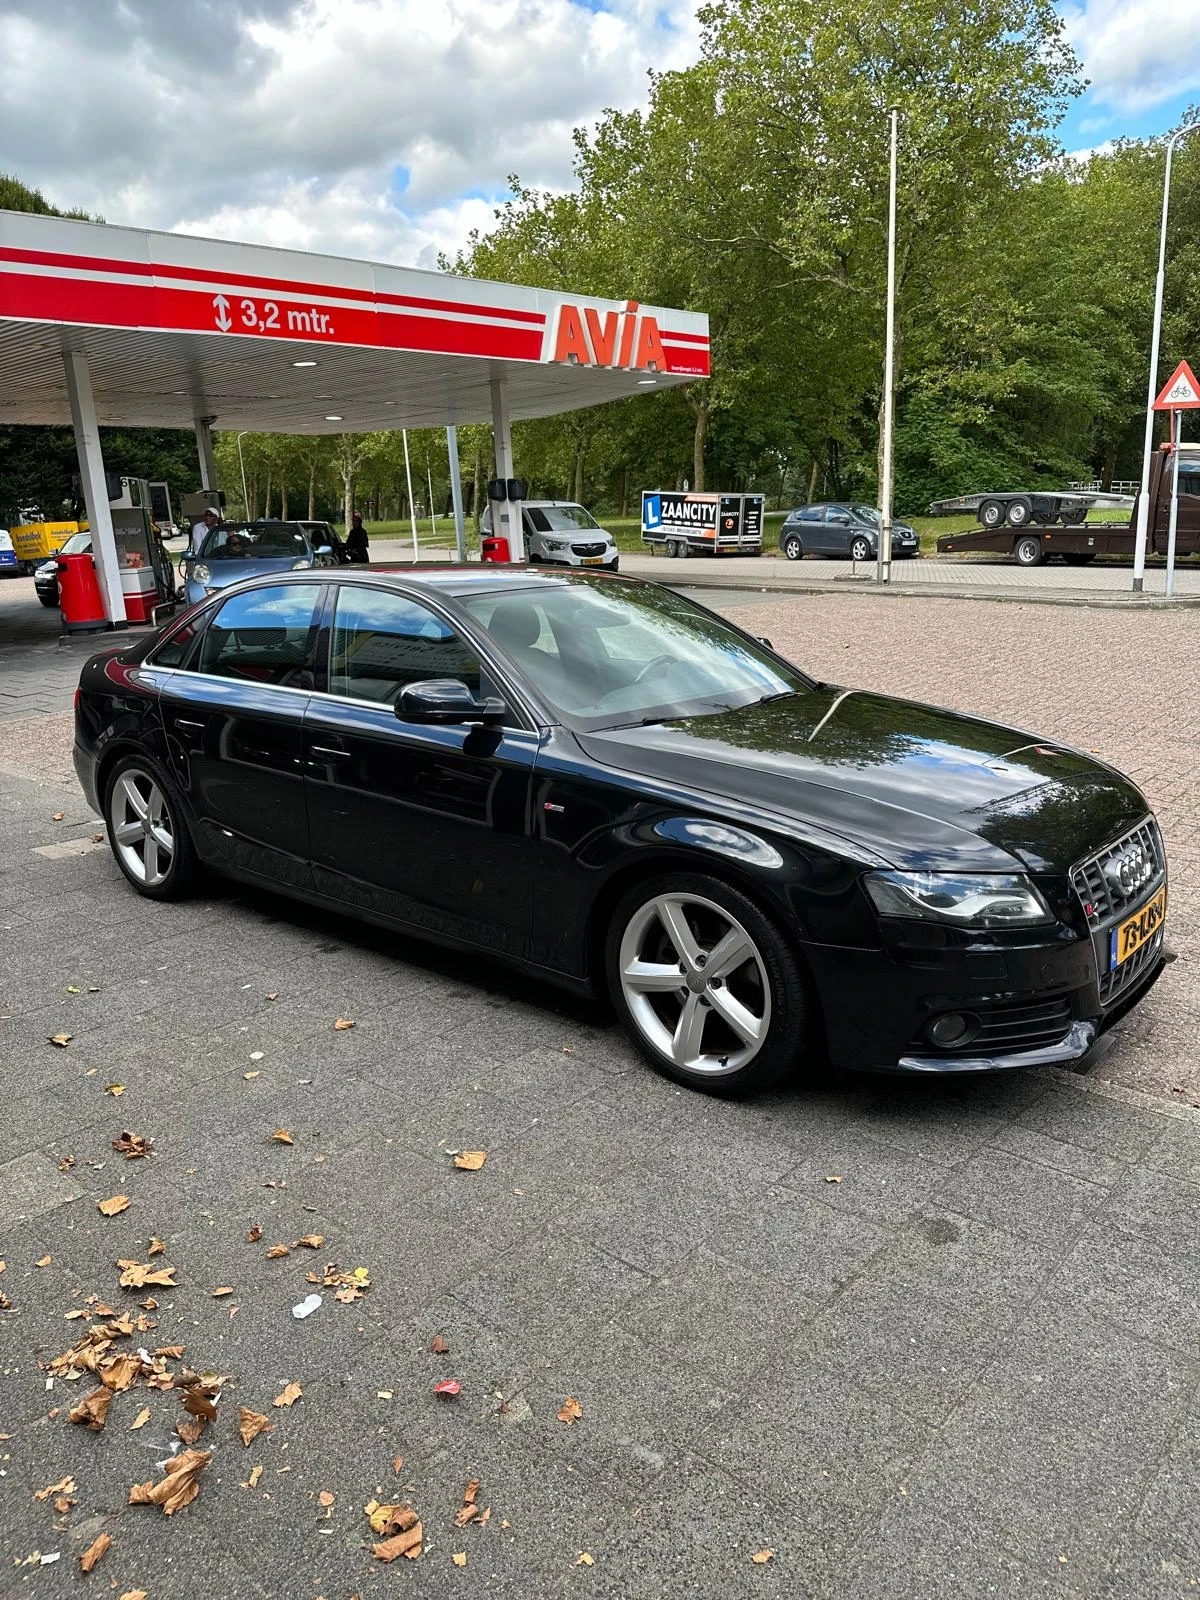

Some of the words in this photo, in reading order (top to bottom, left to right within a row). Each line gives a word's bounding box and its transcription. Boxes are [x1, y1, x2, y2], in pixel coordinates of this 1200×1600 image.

[240, 299, 281, 332] 3,2
[287, 308, 335, 334] mtr.
[120, 477, 128, 487] 6
[647, 501, 659, 525] L
[661, 501, 717, 522] ZAANCITY
